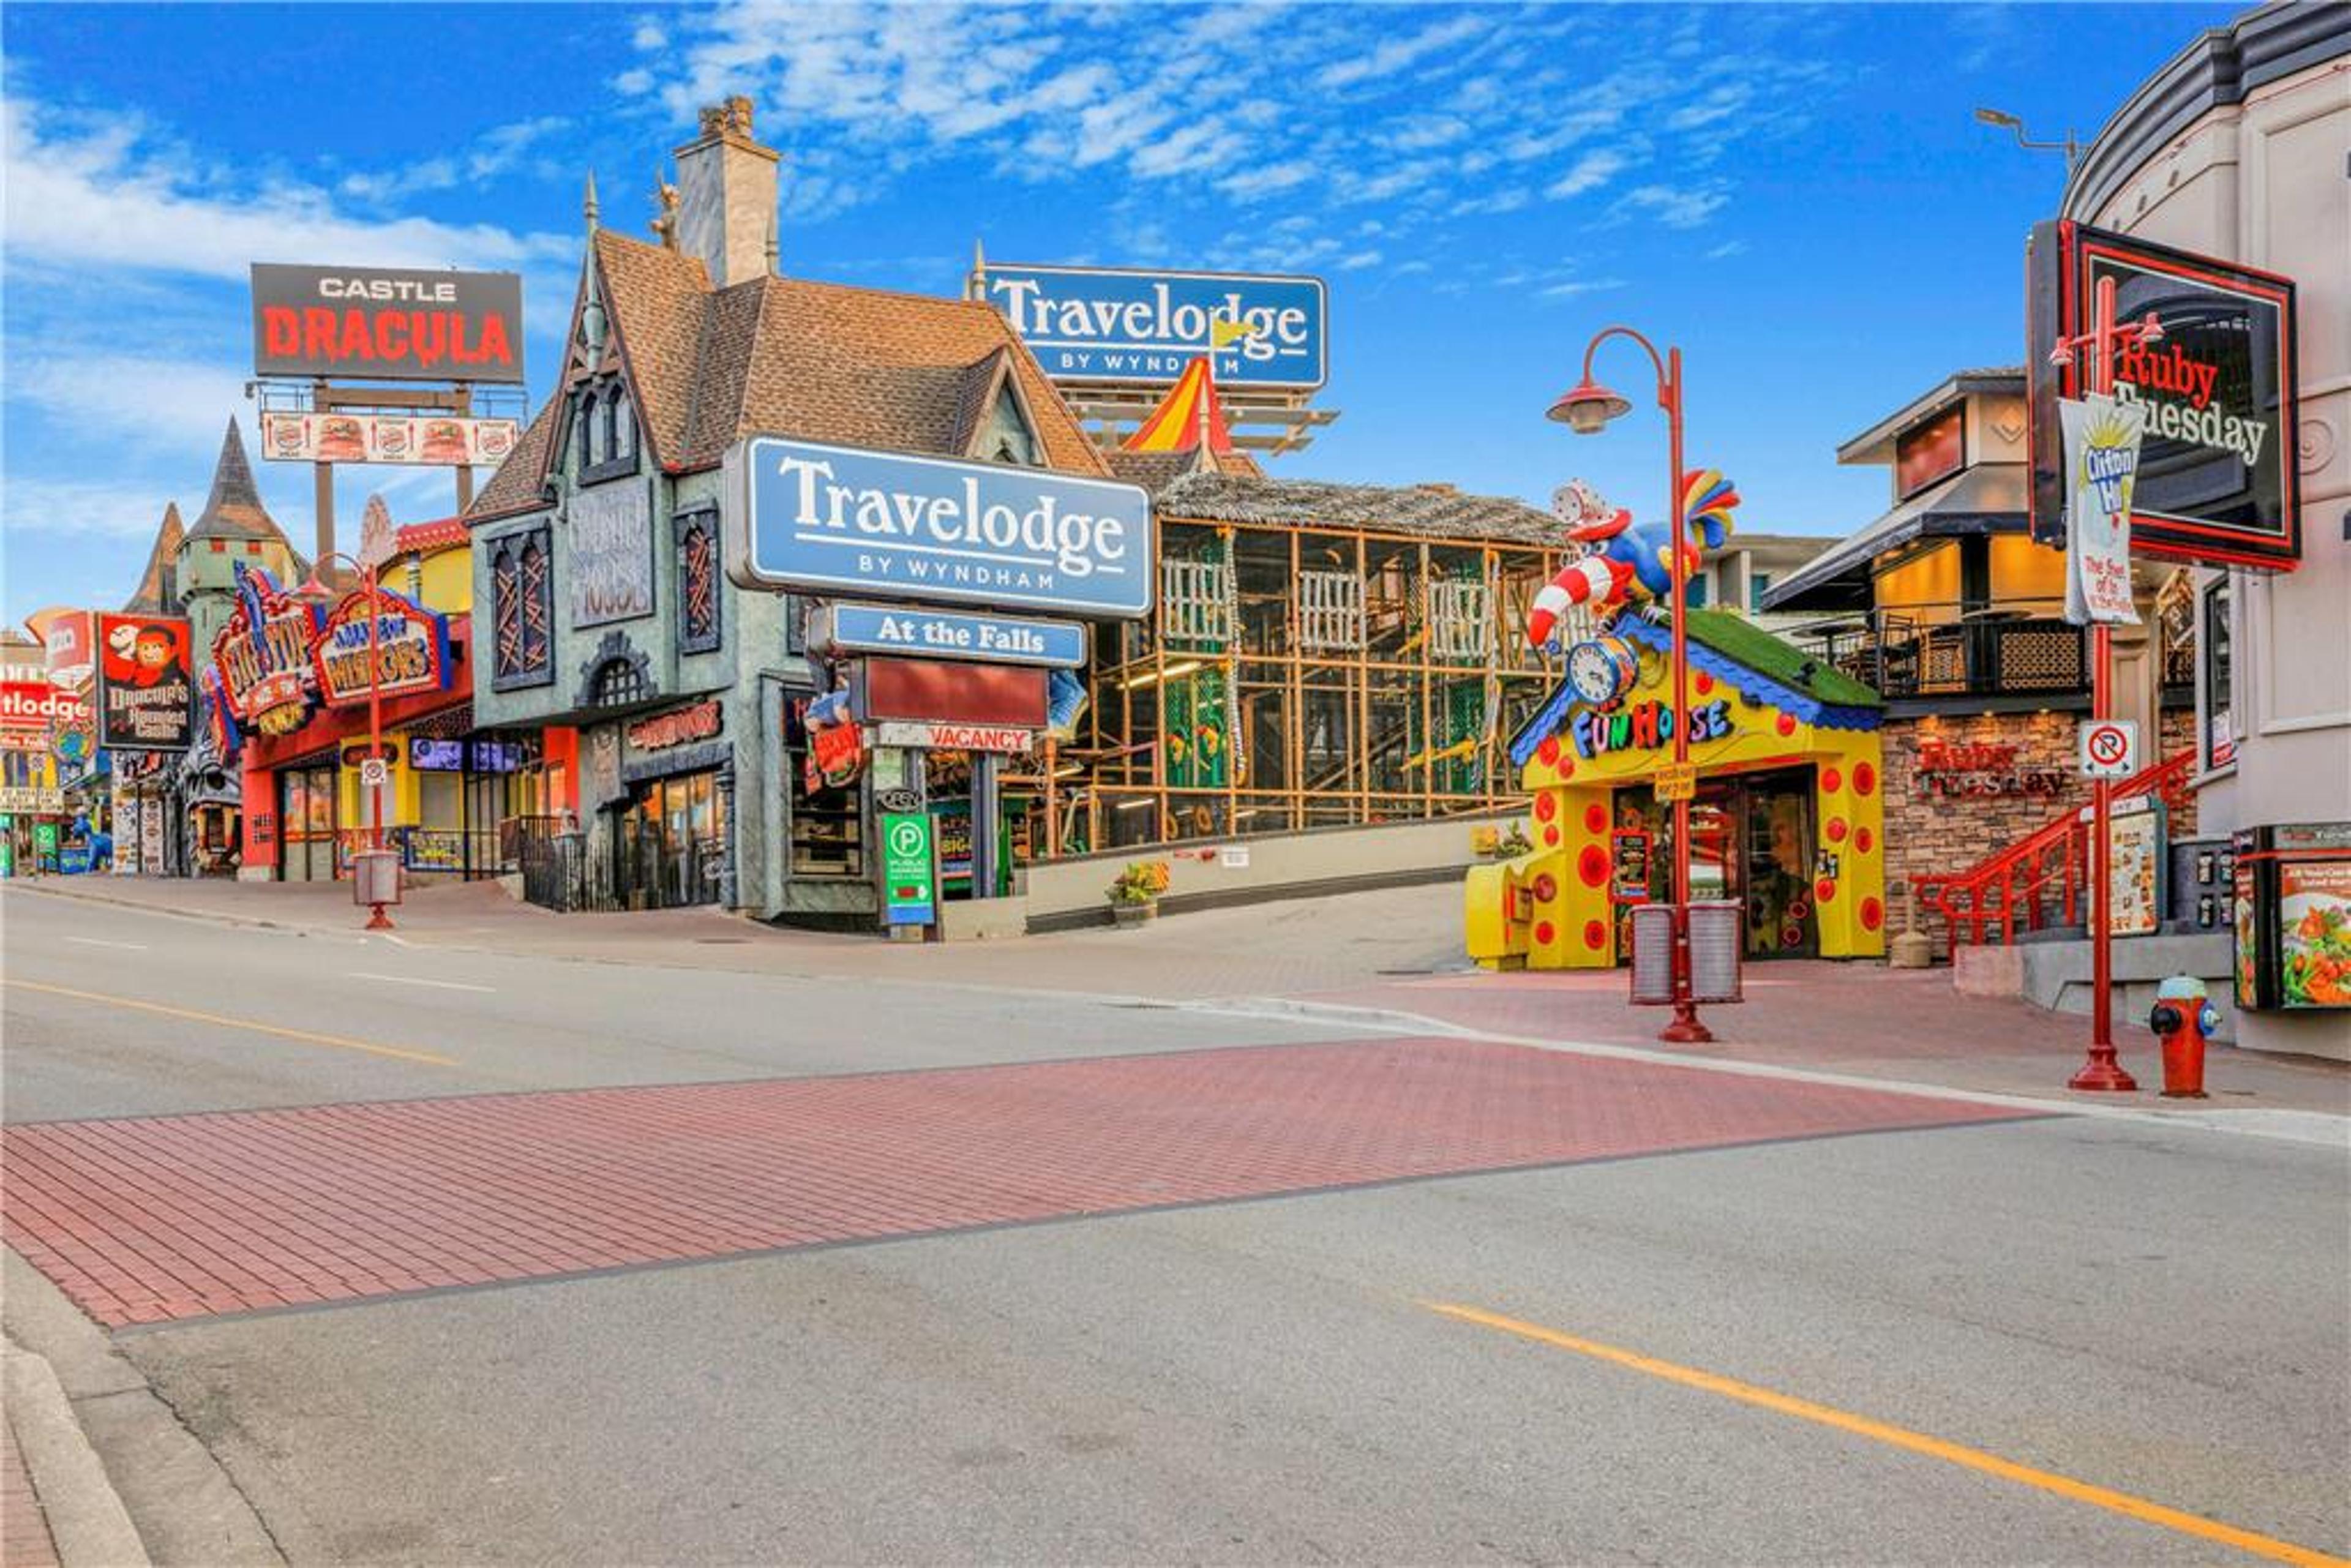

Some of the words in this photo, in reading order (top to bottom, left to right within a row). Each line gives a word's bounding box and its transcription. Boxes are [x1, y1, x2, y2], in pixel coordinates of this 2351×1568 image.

[319, 278, 457, 301] CASTLE
[262, 306, 513, 368] DRACULA
[992, 279, 1307, 360] Travelodge
[1061, 354, 1090, 368] BY
[1105, 355, 1239, 373] WYNDM
[2118, 331, 2218, 410] Ruby
[779, 457, 1125, 577] Travelodge
[860, 555, 892, 574] BY
[909, 560, 1054, 590] WYNDHAM
[877, 616, 915, 641] At
[923, 621, 972, 647] the
[978, 624, 1045, 653] Falls
[929, 727, 1028, 749] VACANCY
[1572, 710, 1630, 759] FUN
[1633, 699, 1729, 749] HOSE
